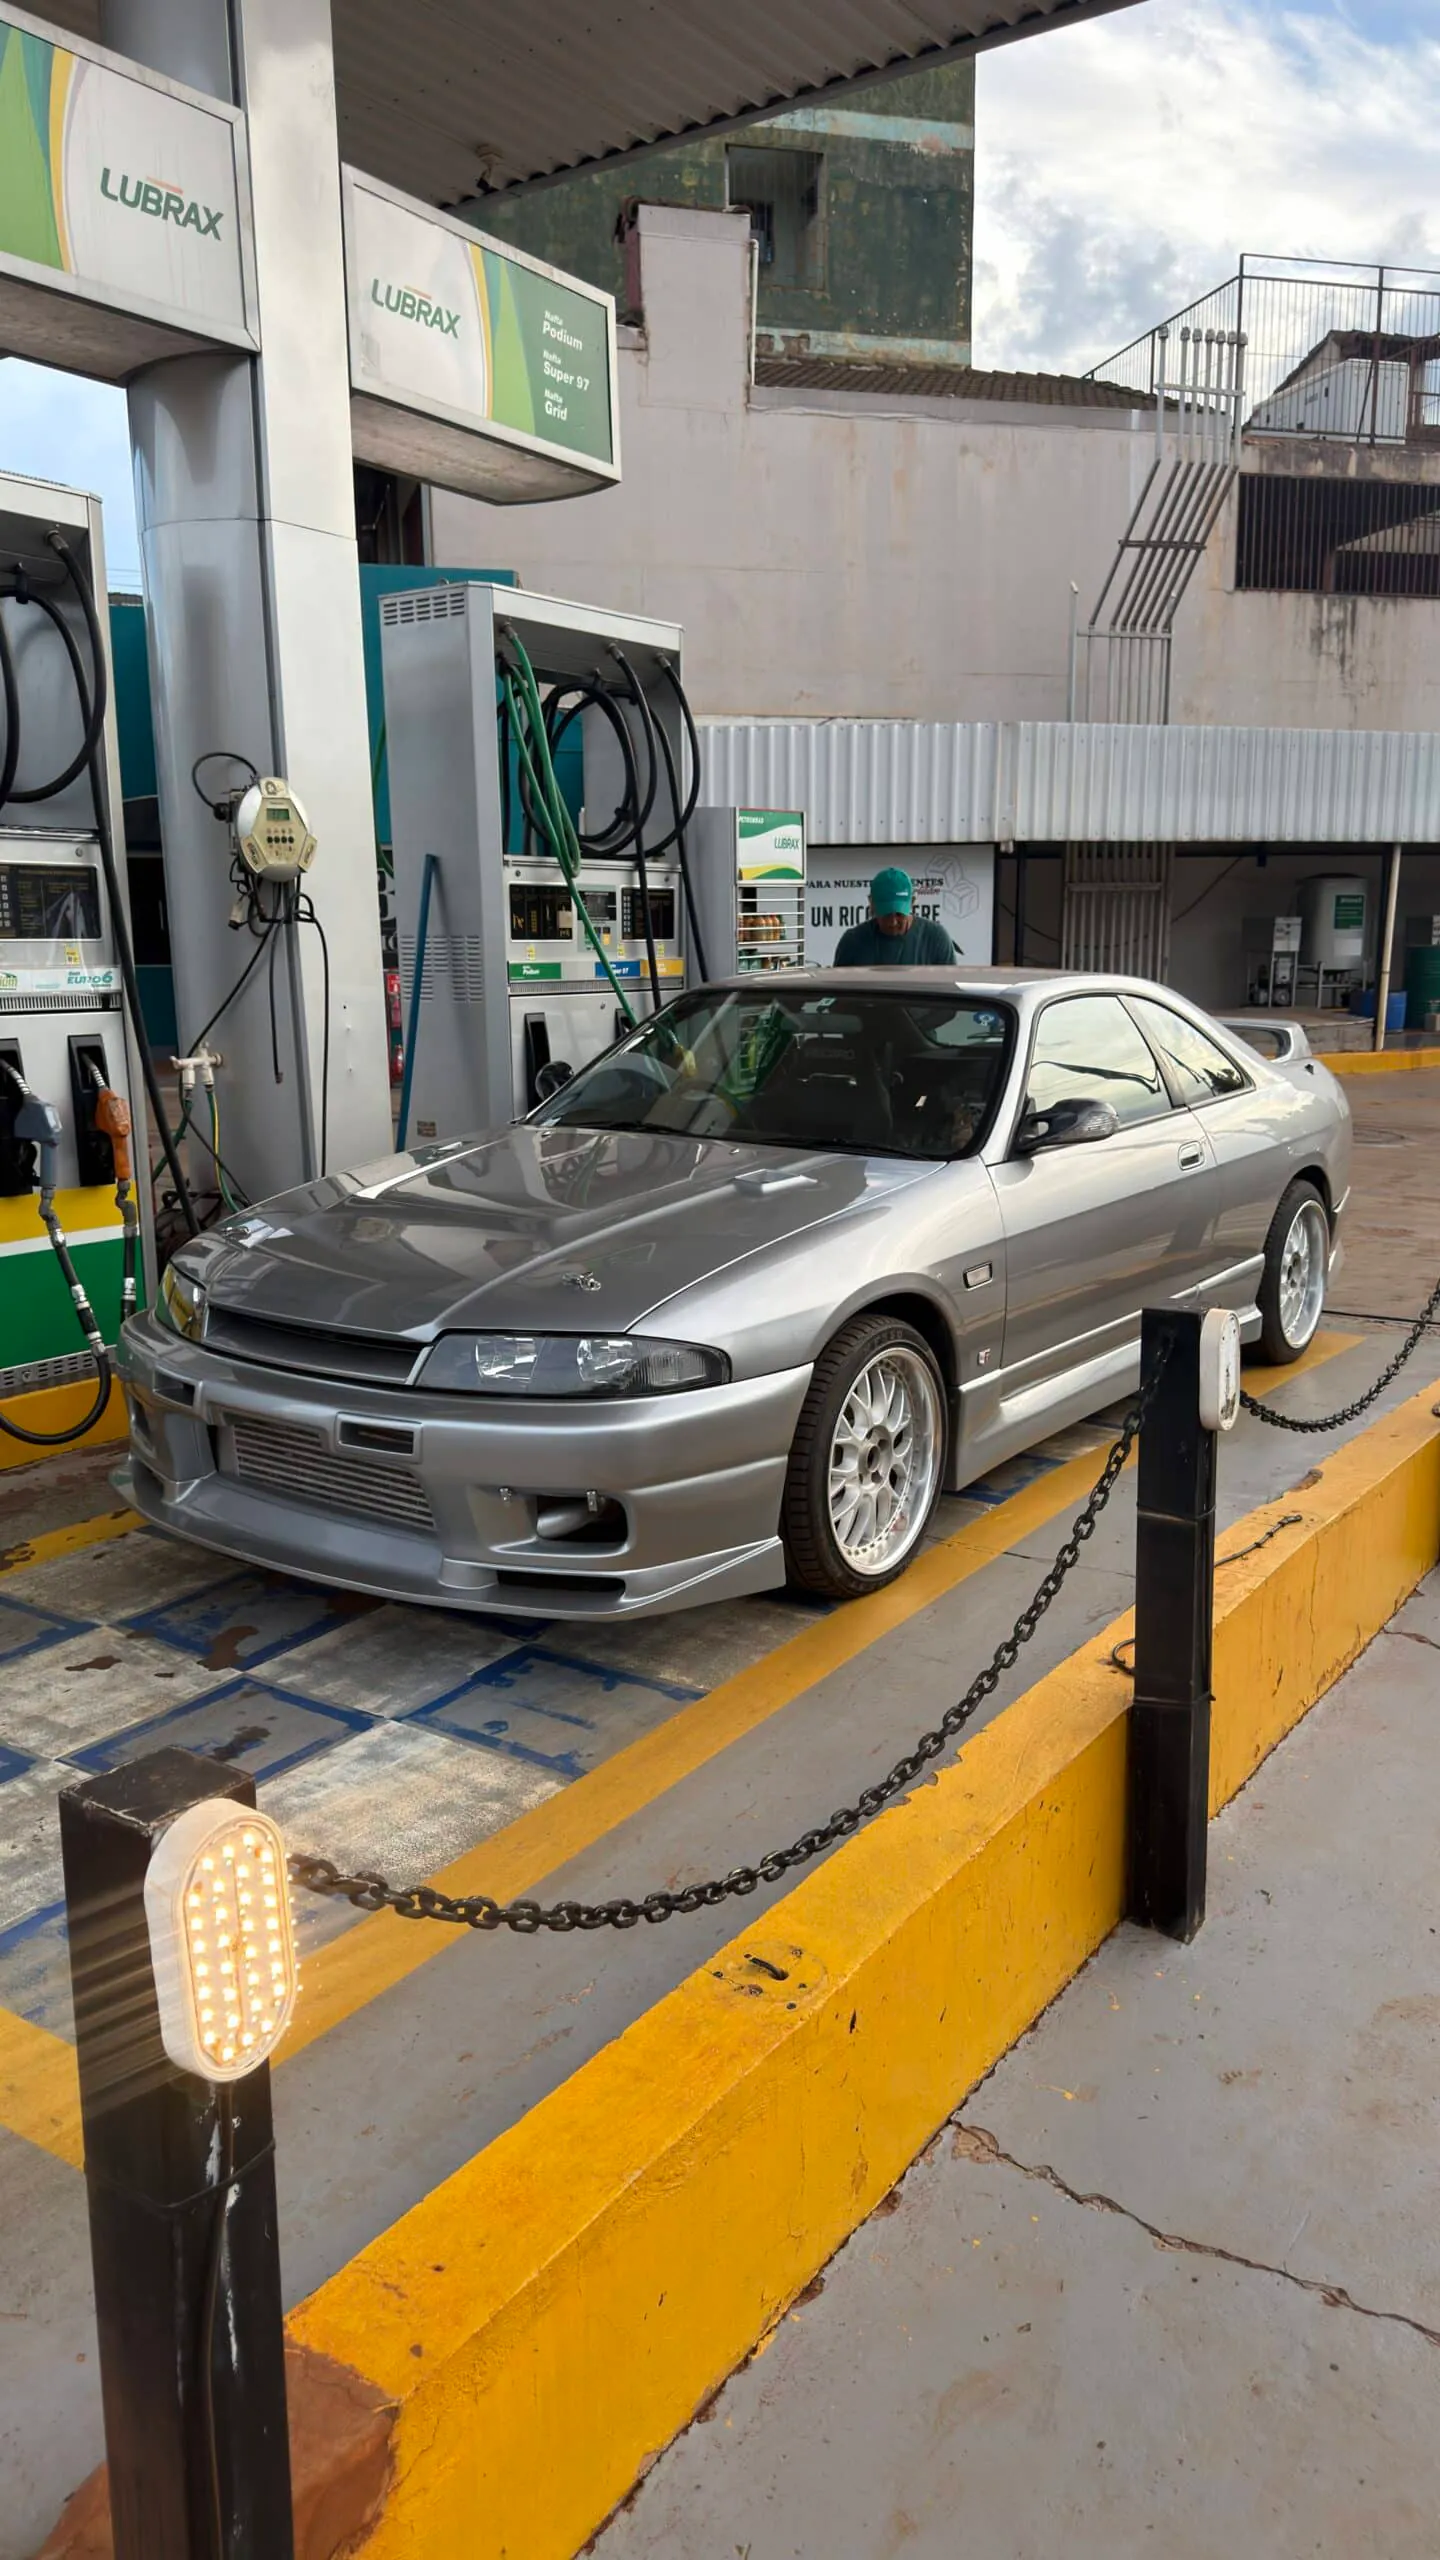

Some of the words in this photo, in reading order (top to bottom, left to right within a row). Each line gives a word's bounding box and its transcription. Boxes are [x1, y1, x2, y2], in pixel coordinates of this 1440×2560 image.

[100, 167, 224, 241] LUBRAX
[371, 278, 461, 339] LUBRAX
[542, 320, 583, 351] Podium
[543, 361, 574, 384] Super
[576, 375, 590, 391] 97
[544, 400, 568, 421] Grid
[774, 835, 800, 849] LUBRAX
[834, 880, 872, 889] NUEST
[911, 878, 944, 887] ENTES
[811, 906, 833, 928] UN
